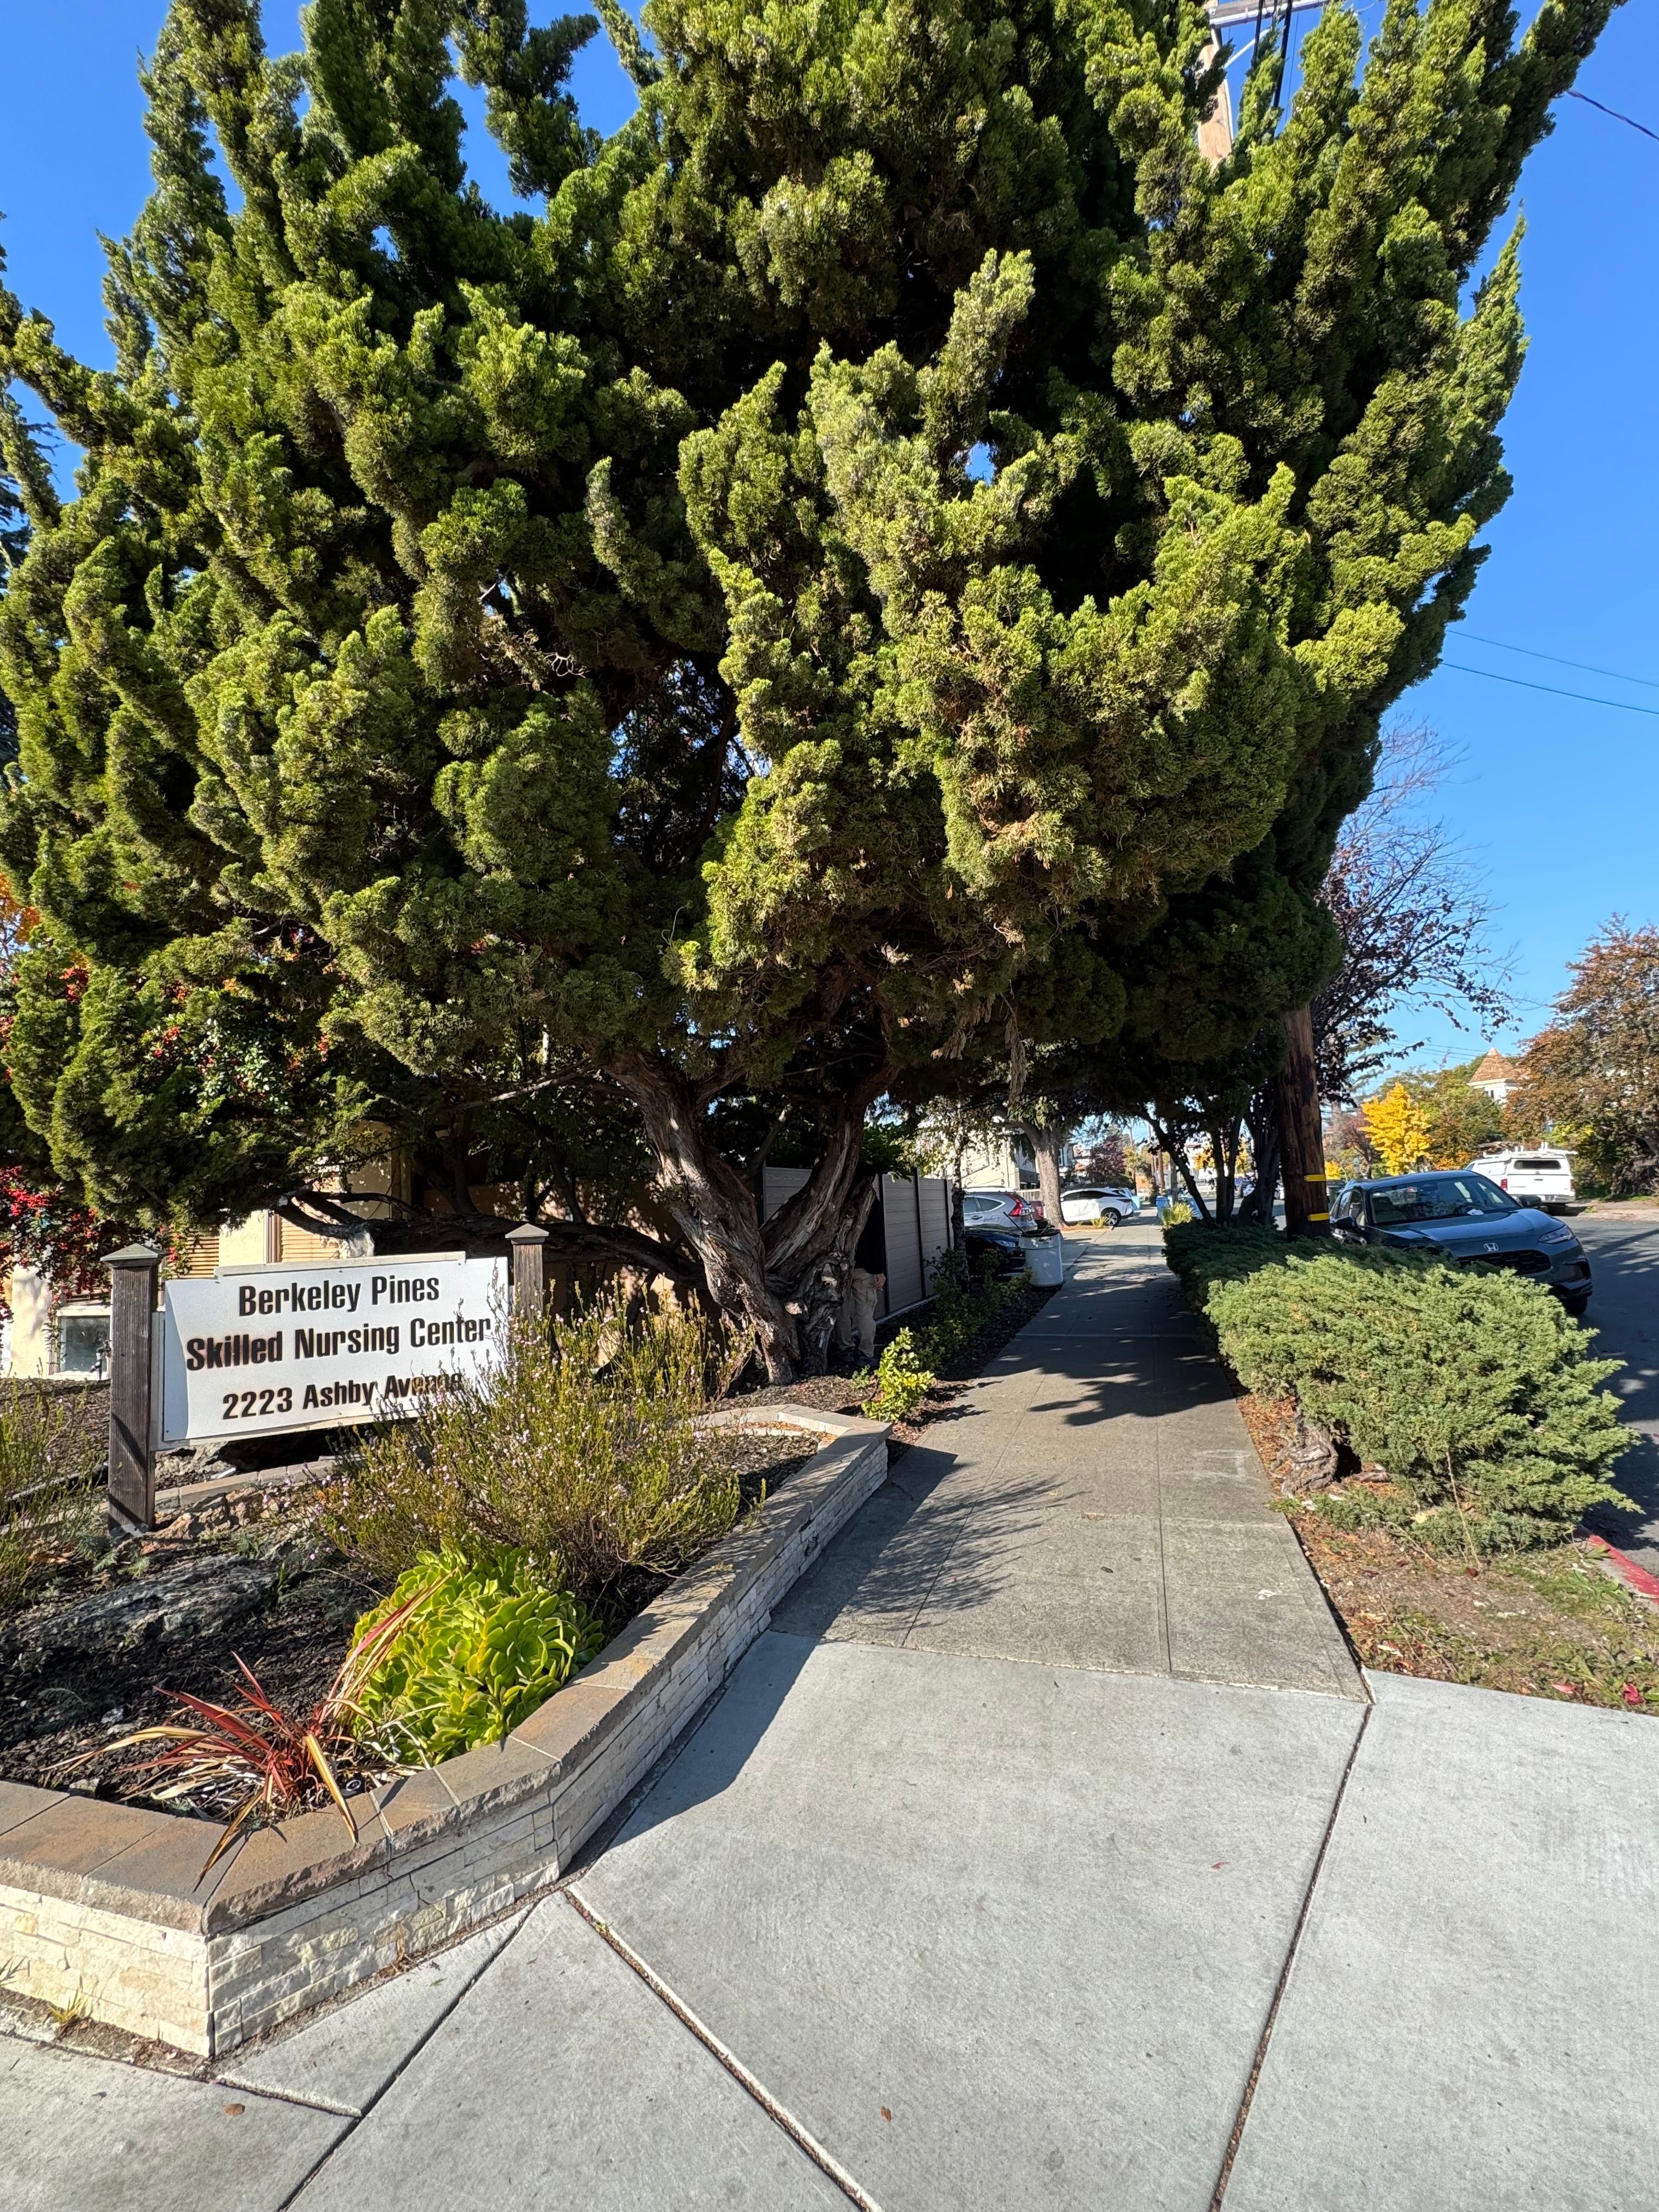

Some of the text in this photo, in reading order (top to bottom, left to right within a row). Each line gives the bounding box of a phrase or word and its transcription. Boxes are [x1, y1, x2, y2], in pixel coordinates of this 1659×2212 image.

[239, 1274, 440, 1317] Berkeley Pines
[187, 1317, 491, 1371] Skilled Nursing Center
[222, 1387, 292, 1420] 2223
[302, 1379, 376, 1410] Ashby
